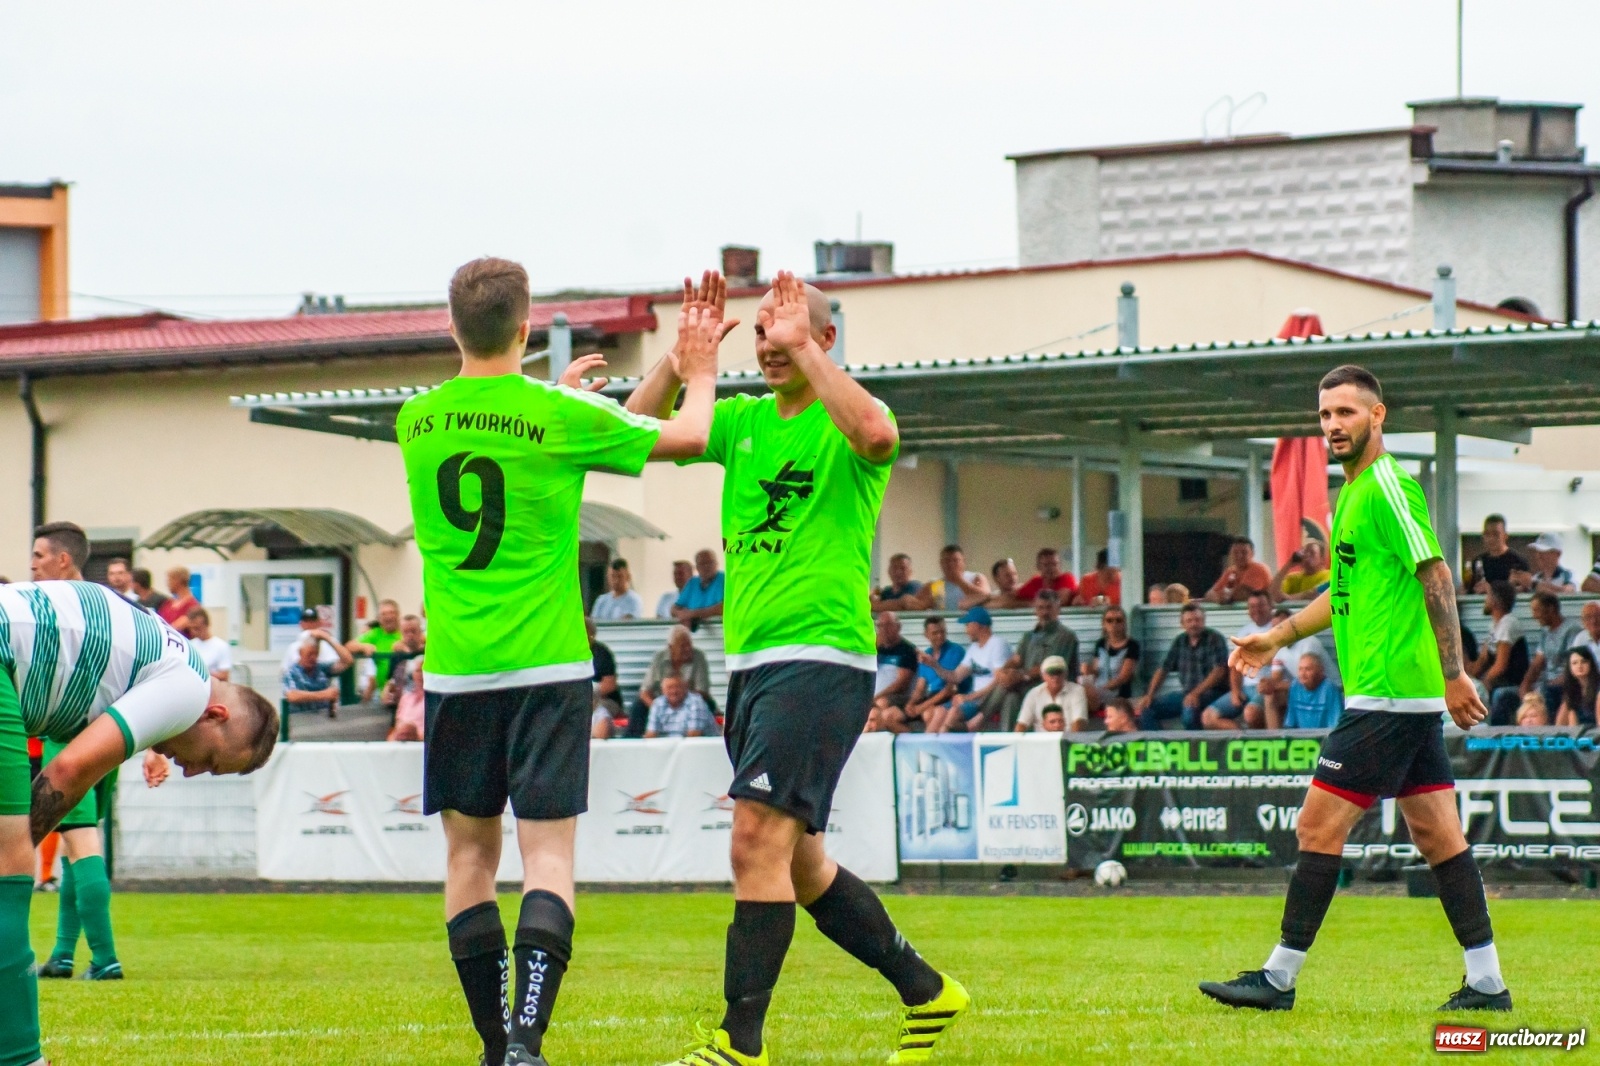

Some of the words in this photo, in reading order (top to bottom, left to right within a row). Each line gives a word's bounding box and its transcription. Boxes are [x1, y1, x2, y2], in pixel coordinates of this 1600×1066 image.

[406, 415, 434, 443] LKS
[444, 412, 546, 445] TWORKÓW
[436, 450, 506, 571] 9
[1250, 774, 1315, 788] SPORTOW
[989, 814, 1003, 829] KK
[1007, 814, 1059, 829] FENSTER
[1090, 807, 1137, 831] JAKO
[1182, 807, 1228, 831] errea
[519, 950, 549, 1028] TWORKÓW
